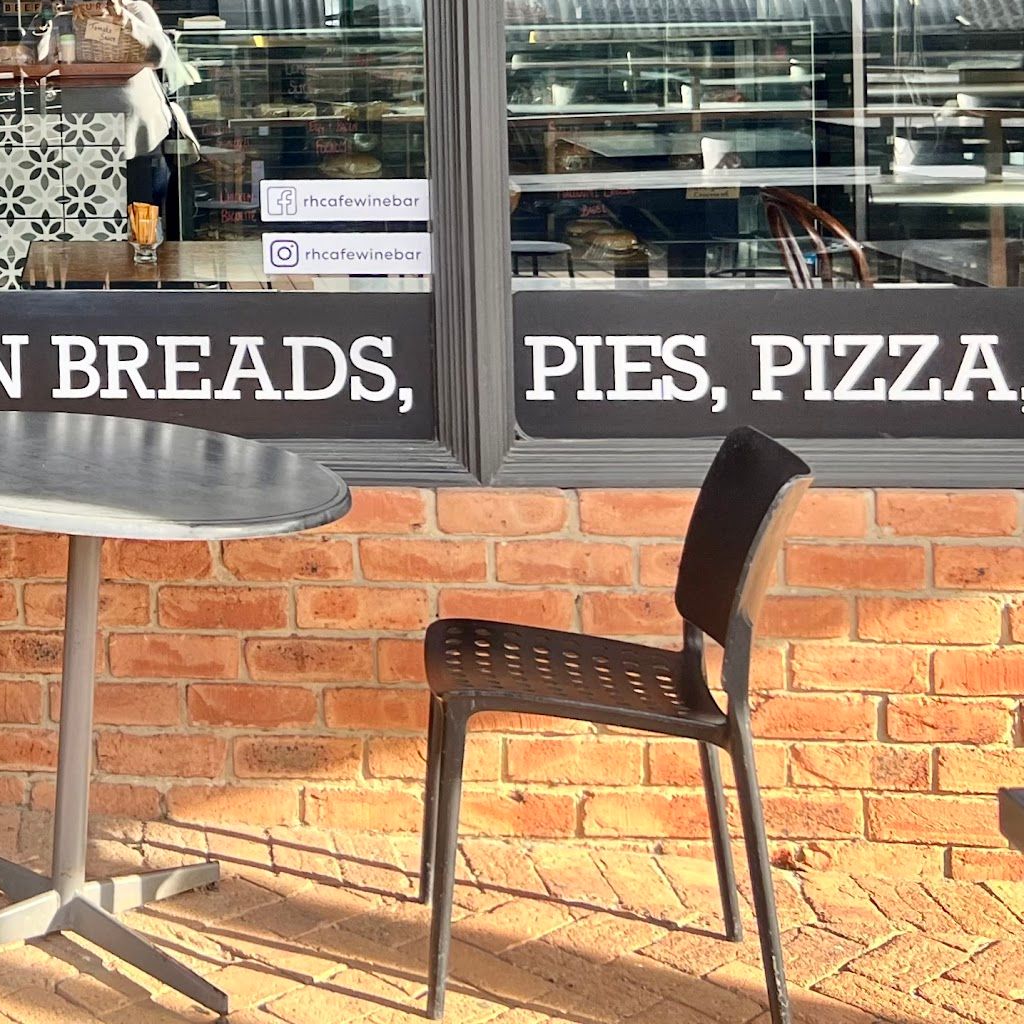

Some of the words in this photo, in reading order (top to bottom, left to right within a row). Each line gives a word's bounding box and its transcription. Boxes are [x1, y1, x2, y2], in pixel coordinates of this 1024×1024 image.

[4, 3, 41, 13] BEEF
[303, 193, 419, 208] rhcafewinebar
[305, 248, 421, 261] rhcafewinebar
[51, 335, 414, 414] BREADS,
[524, 334, 728, 413] PIES,
[750, 334, 1024, 413] PIZZA
